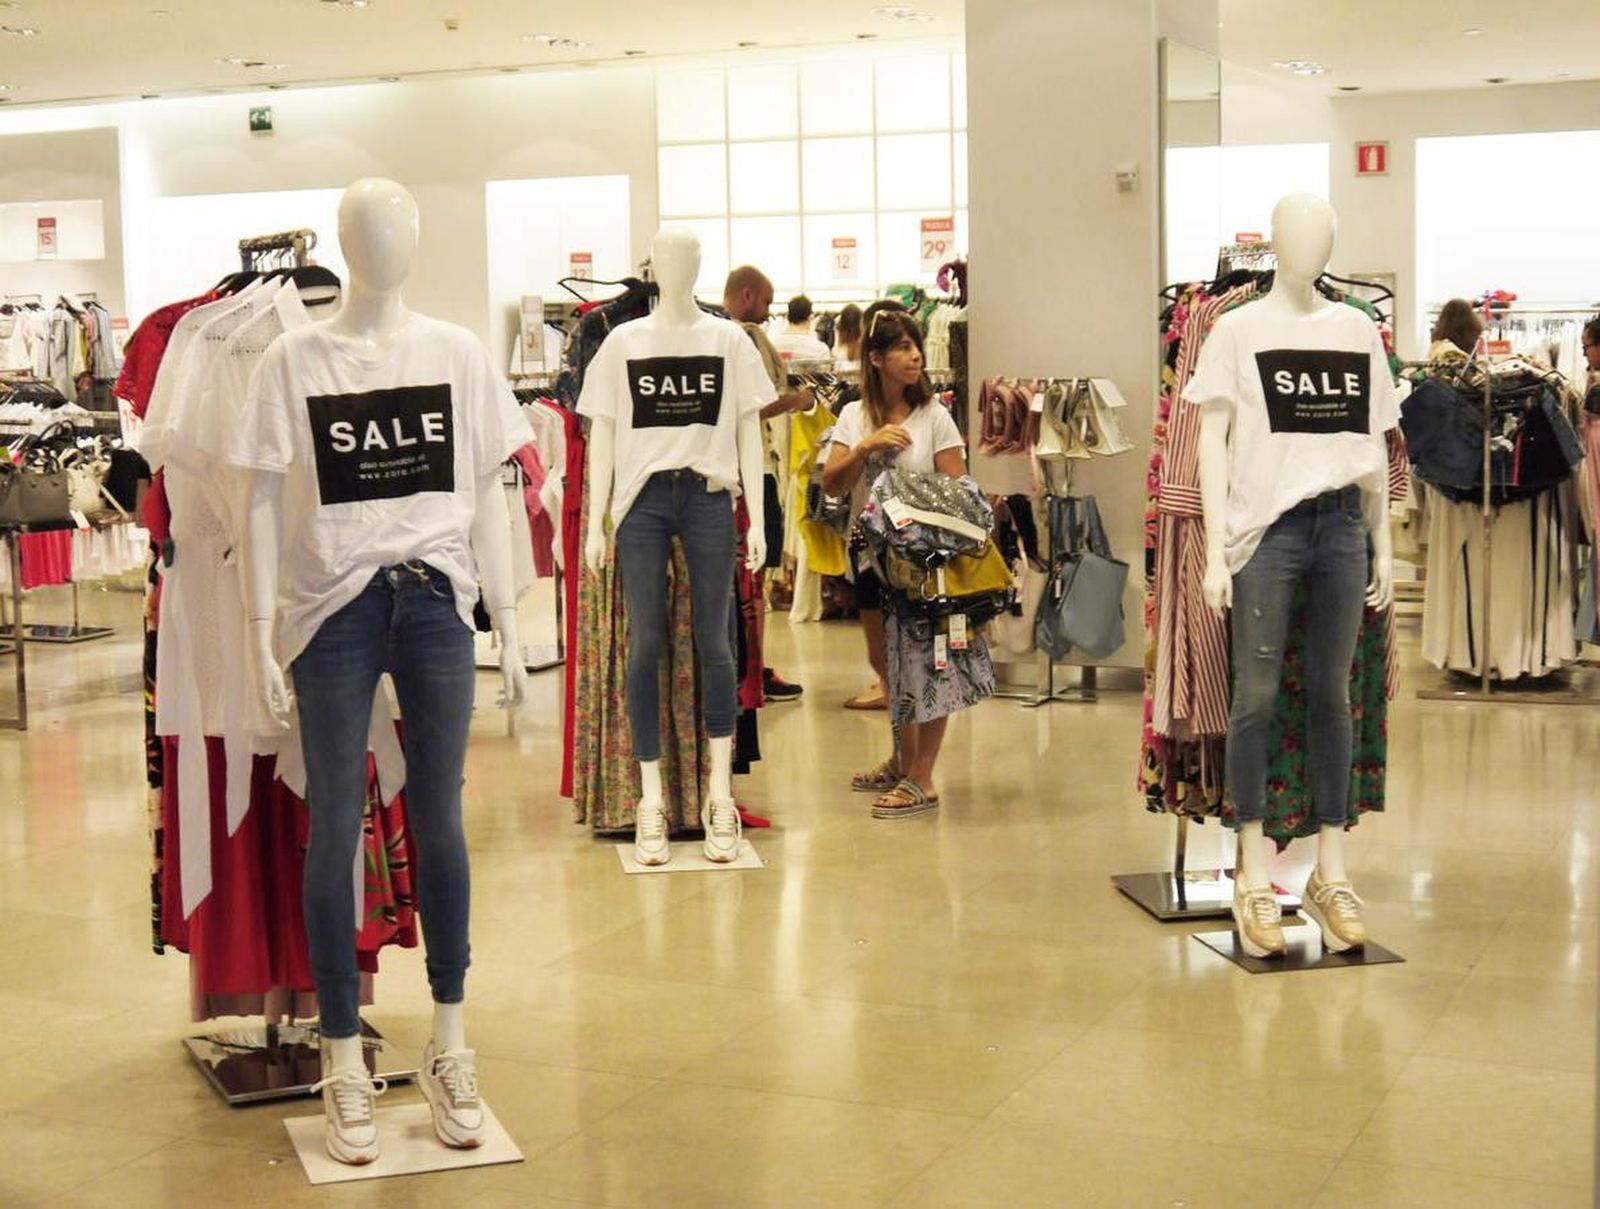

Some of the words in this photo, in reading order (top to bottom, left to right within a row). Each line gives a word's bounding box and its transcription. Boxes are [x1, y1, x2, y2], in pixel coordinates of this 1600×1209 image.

[836, 253, 852, 269] 12
[923, 240, 947, 260] 29
[638, 373, 717, 396] SALE
[1273, 369, 1362, 397] SALE
[329, 411, 446, 453] SALE
